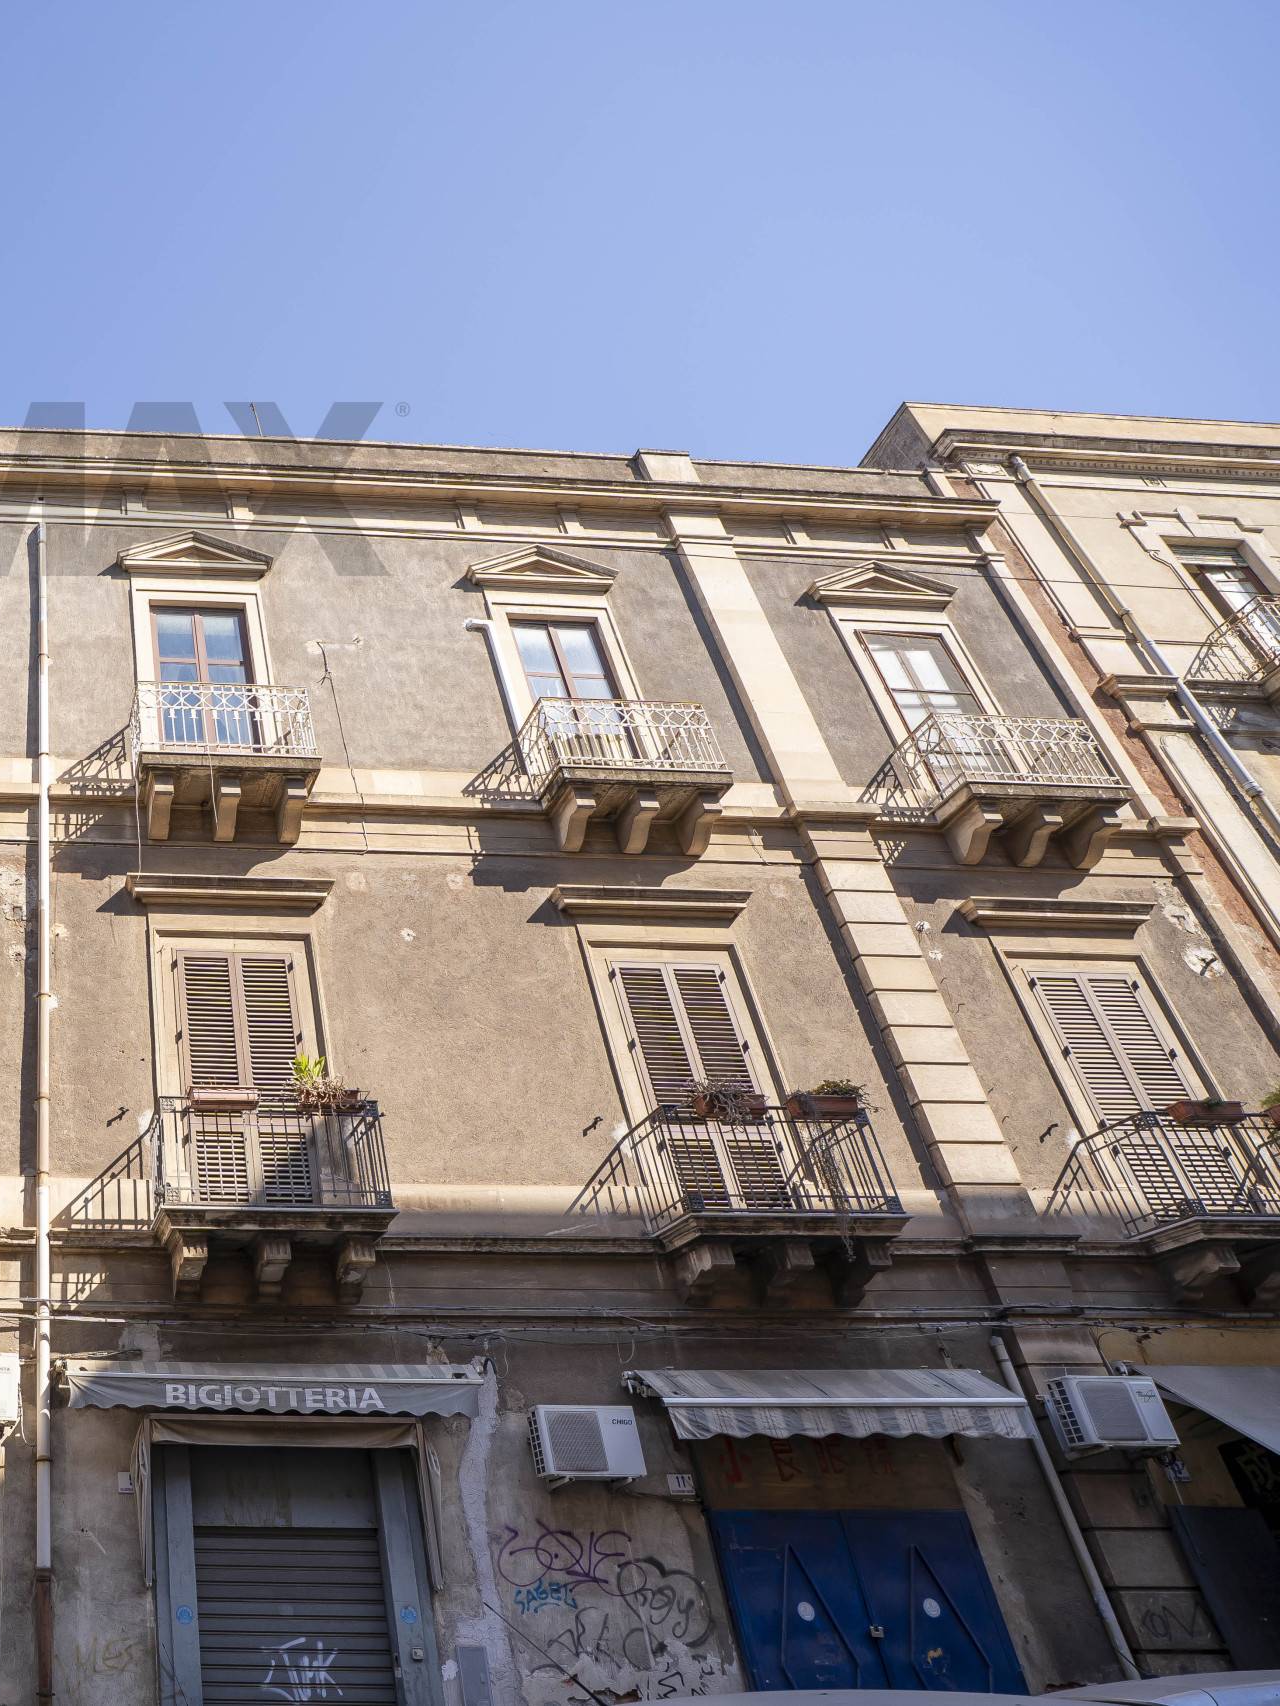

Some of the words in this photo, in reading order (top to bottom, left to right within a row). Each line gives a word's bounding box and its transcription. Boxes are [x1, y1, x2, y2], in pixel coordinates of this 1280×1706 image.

[165, 1383, 386, 1409] BIGIOTTERIA
[611, 1418, 633, 1426] CHIGO
[675, 1476, 687, 1488] 11
